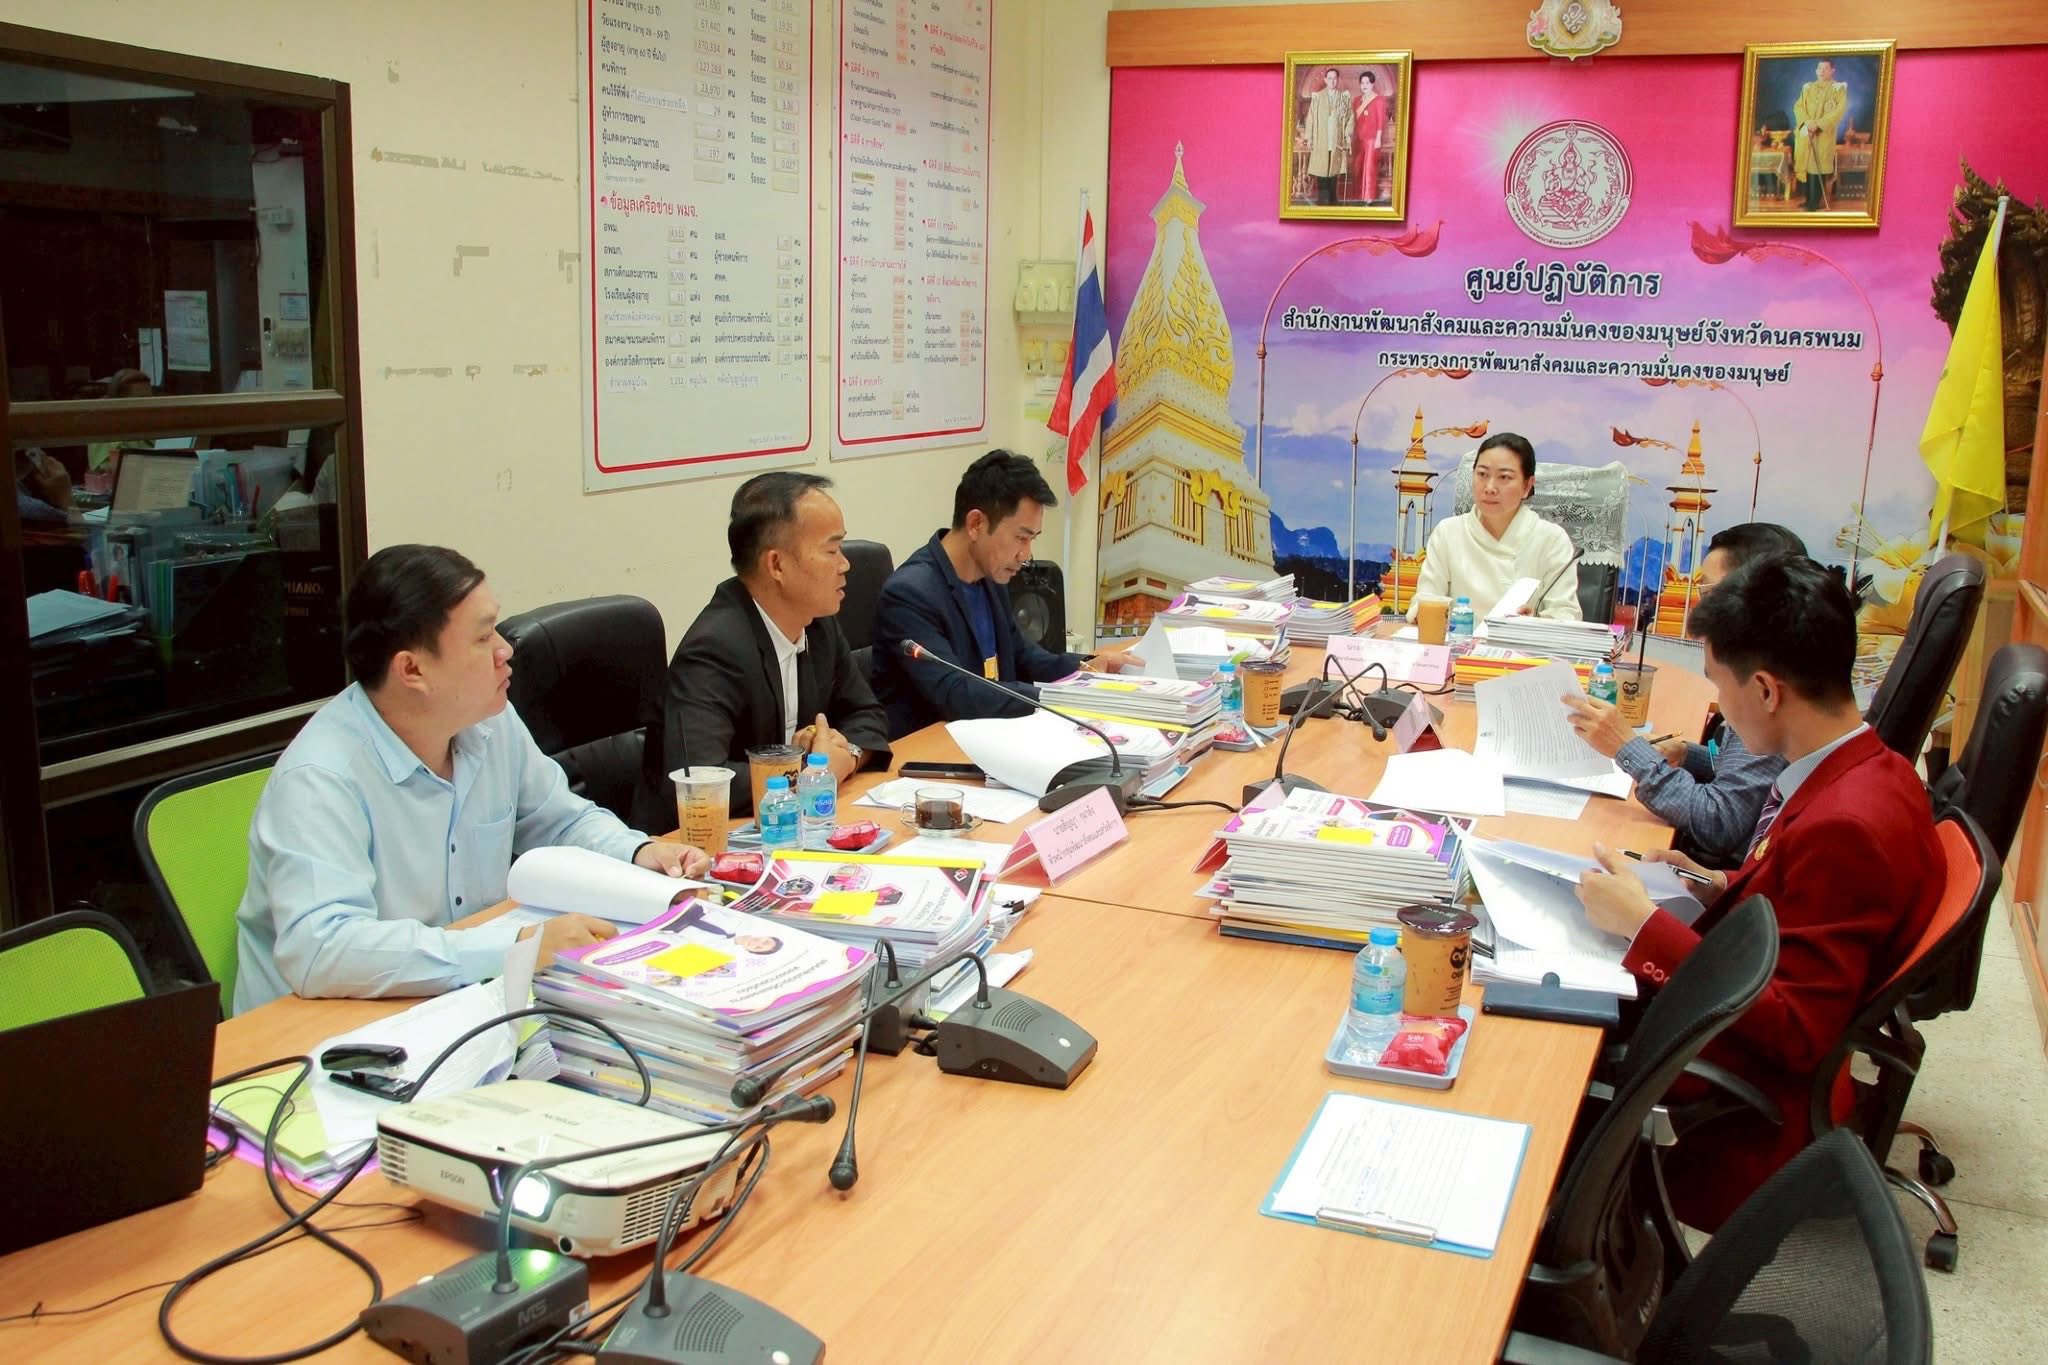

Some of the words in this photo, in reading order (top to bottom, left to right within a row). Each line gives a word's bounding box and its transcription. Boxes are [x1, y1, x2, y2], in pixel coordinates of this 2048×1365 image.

[601, 61, 627, 76] คนพิการ
[601, 104, 646, 124] ผู้ทำการขอทาน
[602, 128, 660, 149] ผู้แสดงความสามารถ
[610, 190, 674, 217] ข้อมูลเครือข่าย
[677, 203, 699, 217] พมจ.
[1466, 260, 1661, 301] ศูนย์ปฏิบัติการ
[1283, 307, 1862, 349] สำนักงานพัฒนาสังคมและความมั่นคงของมนุษย์จังหวัดนครพนม
[1379, 348, 1792, 384] กระทรวงการพัฒนาสังคมและความมั่นคงของมนุษย์
[440, 1169, 466, 1186] EPSON
